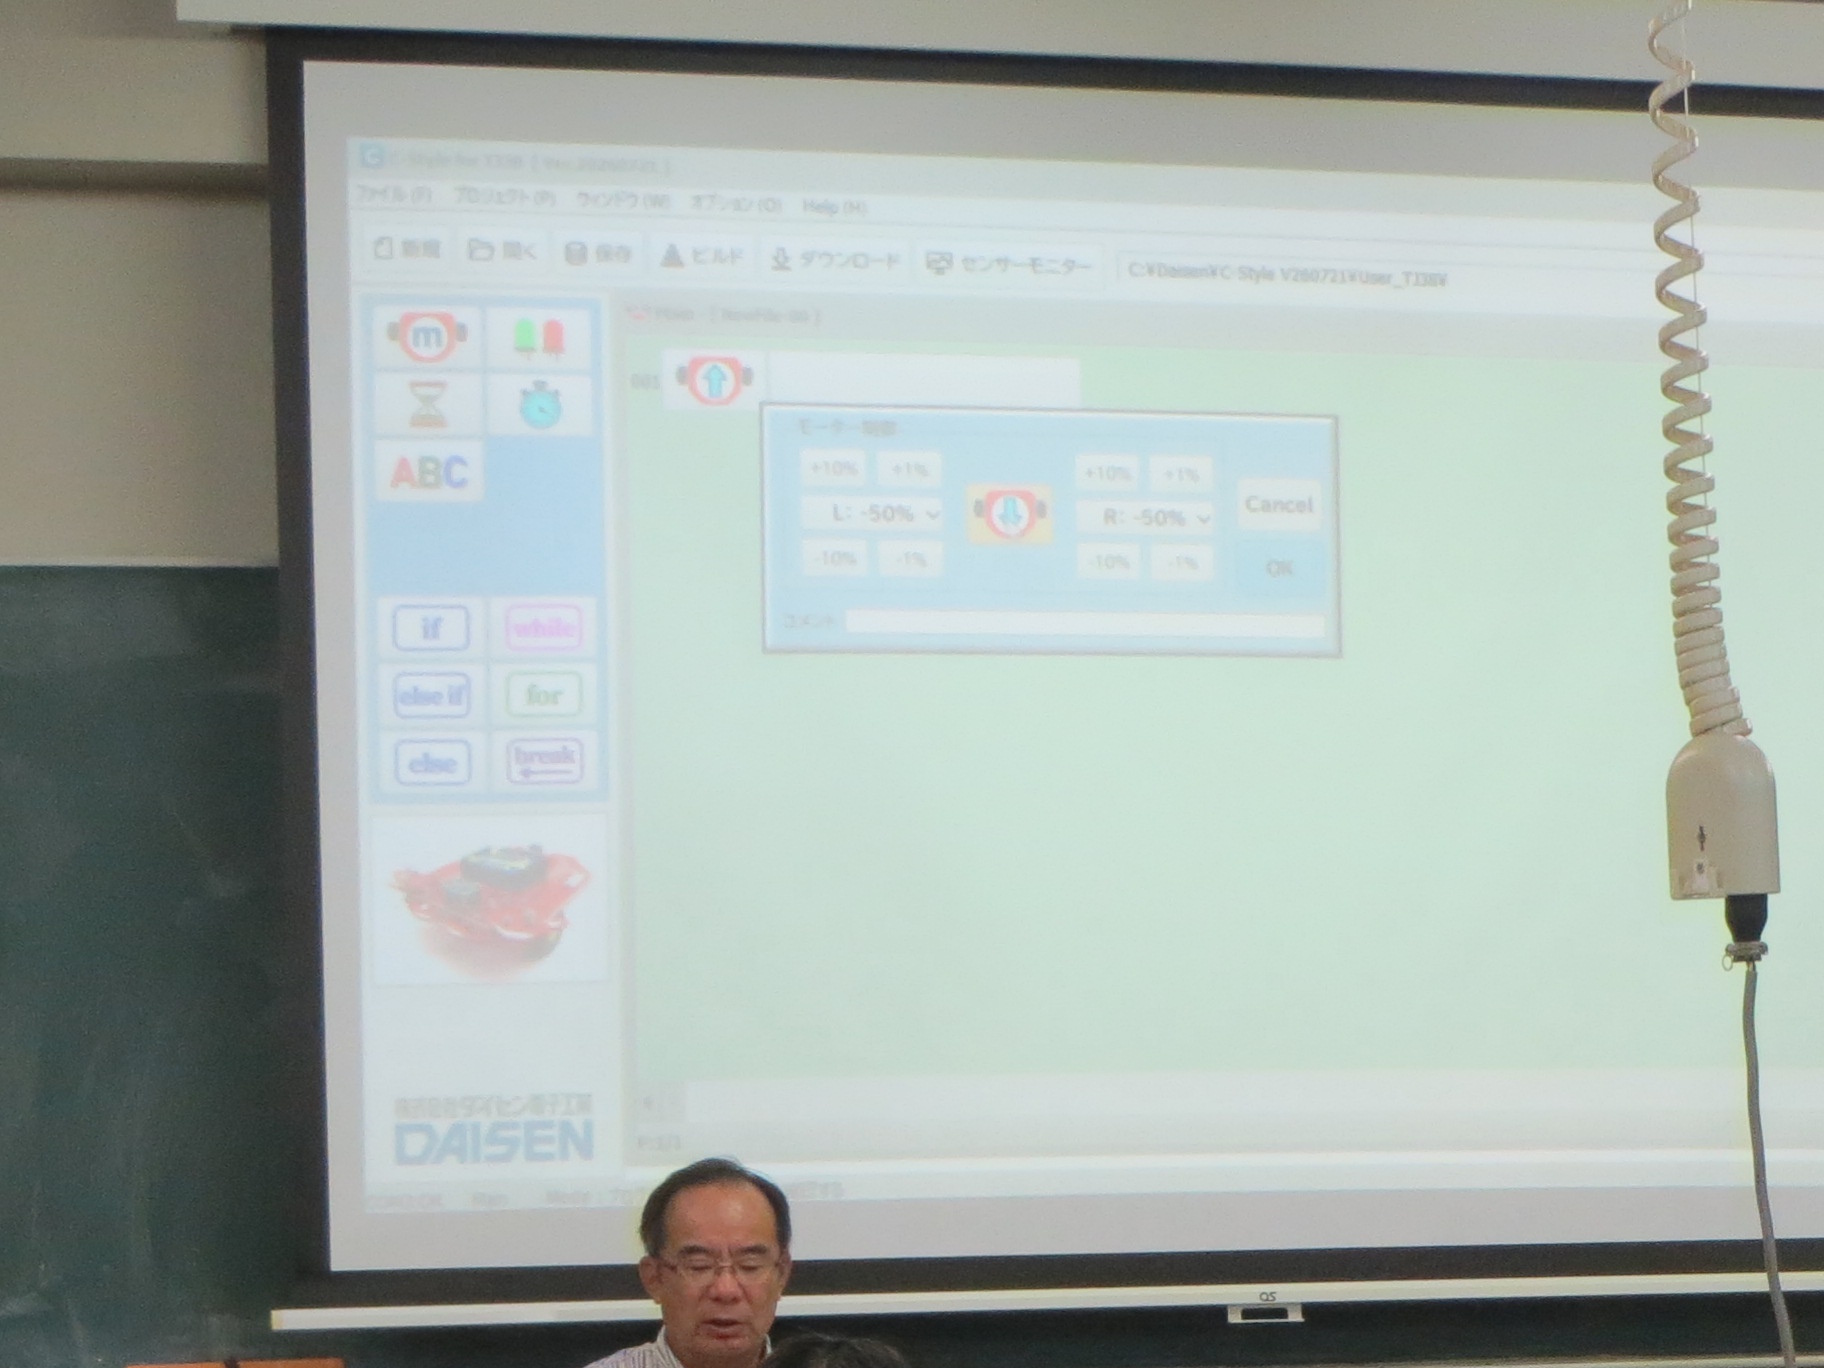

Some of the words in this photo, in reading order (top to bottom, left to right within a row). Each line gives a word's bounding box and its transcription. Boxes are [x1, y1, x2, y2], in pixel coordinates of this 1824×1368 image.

[800, 249, 901, 270] ダウンロード
[961, 255, 1093, 275] センサーモニター
[389, 454, 470, 490] ABC
[1244, 495, 1314, 515] Cancel
[421, 614, 445, 641] if
[526, 683, 565, 707] for
[394, 1119, 594, 1166] DAISEN
